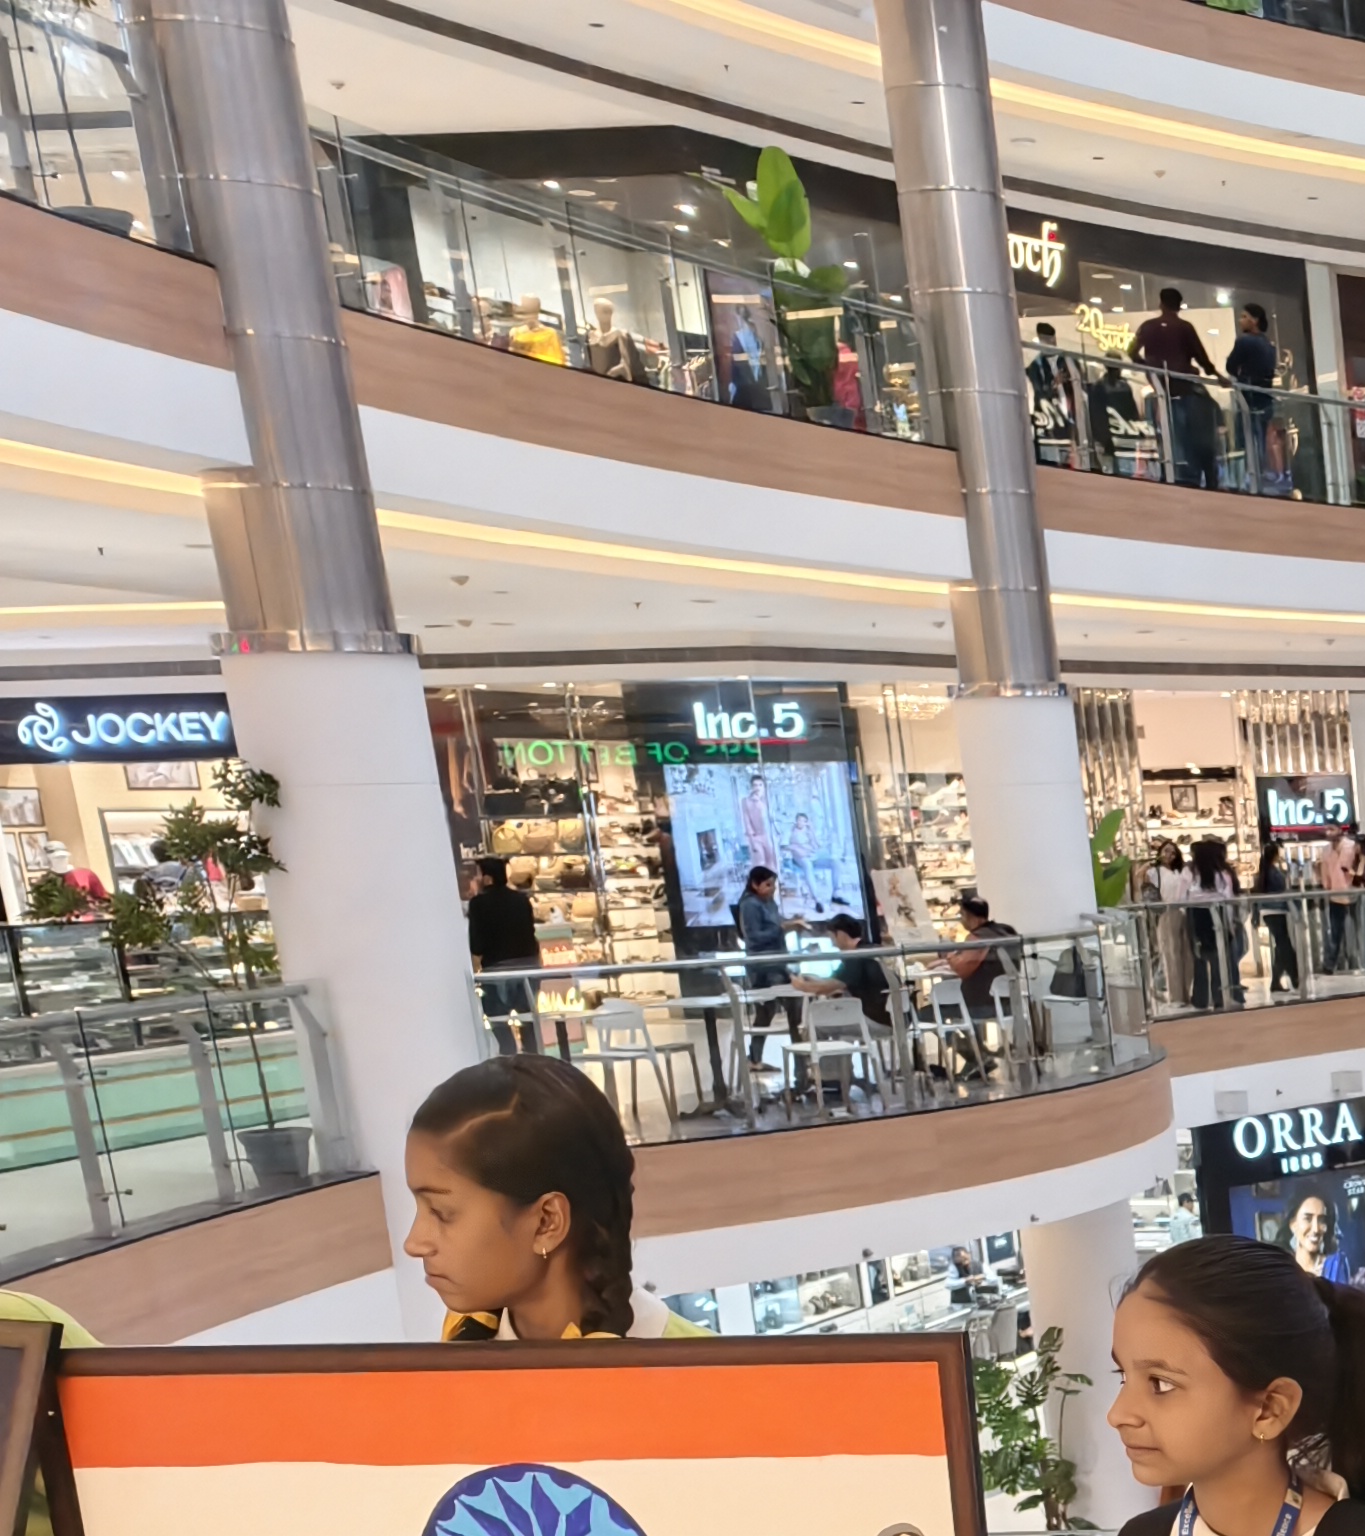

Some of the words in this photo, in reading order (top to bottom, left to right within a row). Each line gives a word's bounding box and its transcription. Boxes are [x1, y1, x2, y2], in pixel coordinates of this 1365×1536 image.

[71, 711, 232, 747] JOCKEY
[1231, 1101, 1363, 1160] ORRA
[1280, 1151, 1324, 1174] 1888
